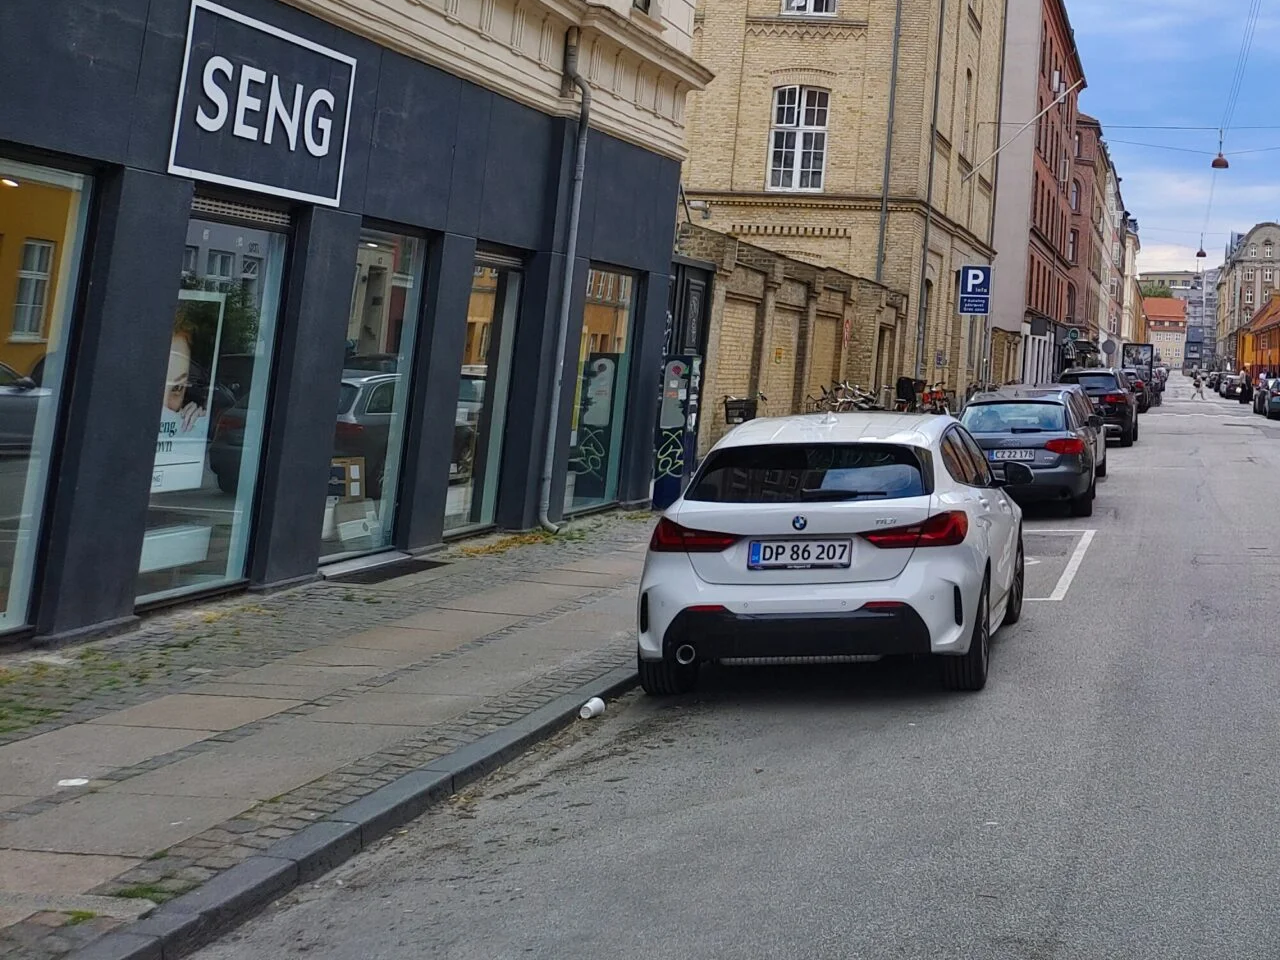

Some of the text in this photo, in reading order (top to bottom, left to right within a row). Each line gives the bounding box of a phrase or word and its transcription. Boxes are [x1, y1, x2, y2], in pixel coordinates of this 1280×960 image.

[196, 55, 335, 157] SENG
[967, 269, 984, 292] P
[1008, 450, 1017, 458] 22
[762, 544, 847, 561] DP 86 207
